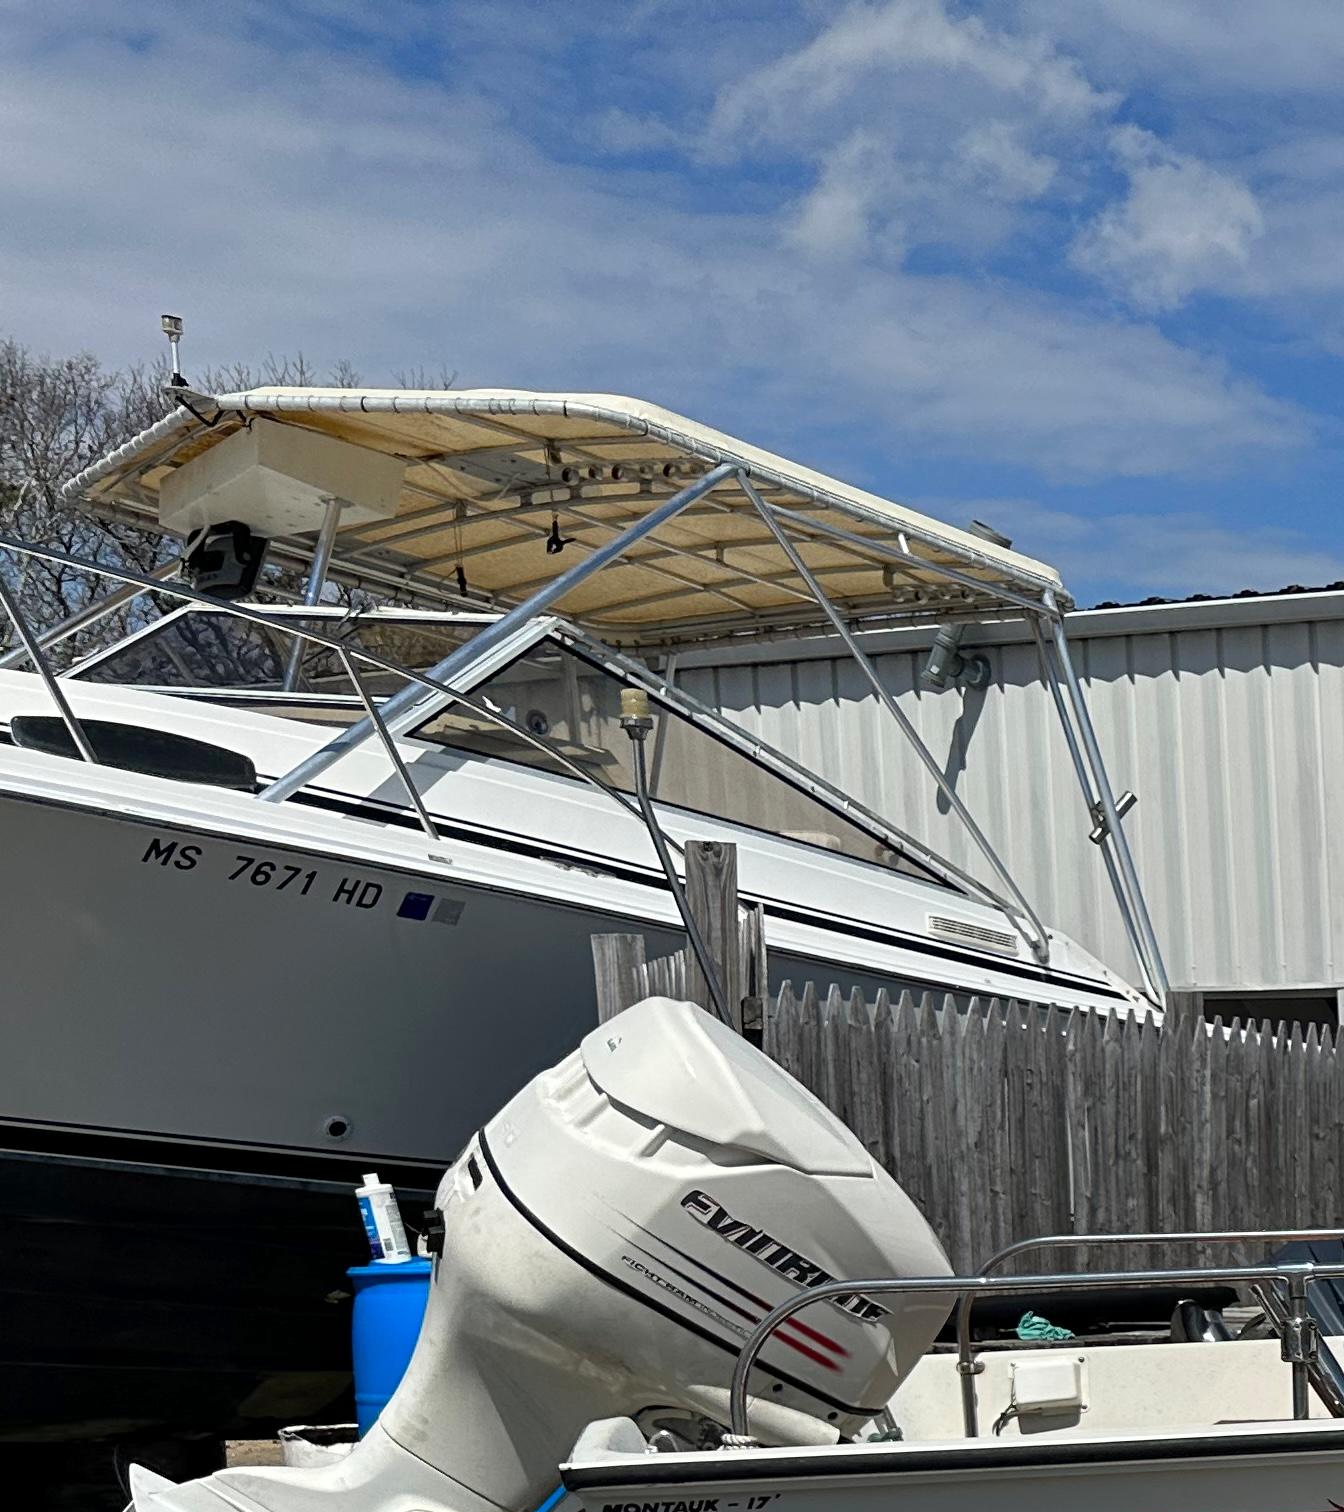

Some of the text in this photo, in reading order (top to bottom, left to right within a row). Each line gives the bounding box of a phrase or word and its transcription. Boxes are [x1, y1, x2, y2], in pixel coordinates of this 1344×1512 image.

[141, 838, 383, 909] MS 7671 HD
